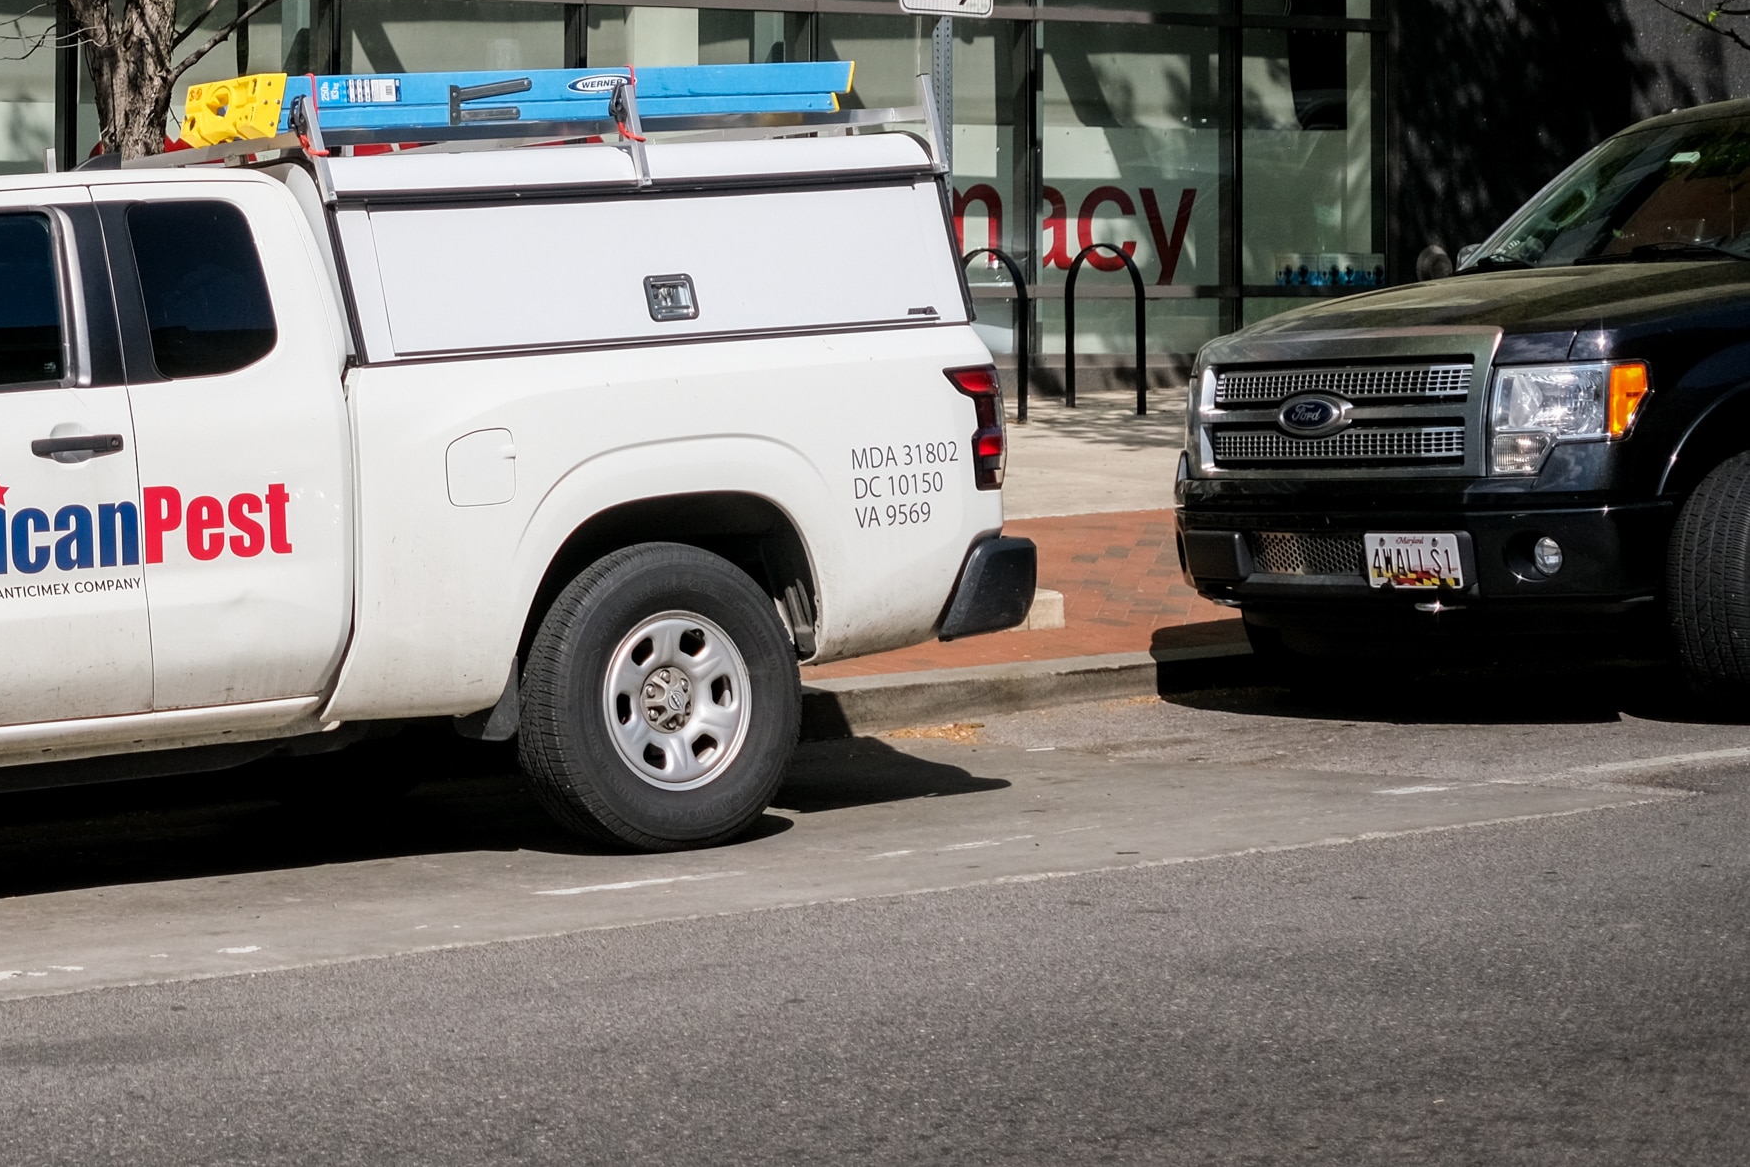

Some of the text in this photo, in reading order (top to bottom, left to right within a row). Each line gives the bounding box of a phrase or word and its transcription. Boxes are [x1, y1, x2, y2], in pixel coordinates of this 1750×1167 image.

[1291, 403, 1322, 422] Ford
[851, 440, 959, 470] MDA 31802
[854, 471, 943, 500] DC 10150
[854, 501, 931, 529] VA 9569
[1395, 536, 1424, 546] Maryland
[1373, 548, 1452, 575] 4WALLS1
[74, 577, 142, 595] COMPANY
